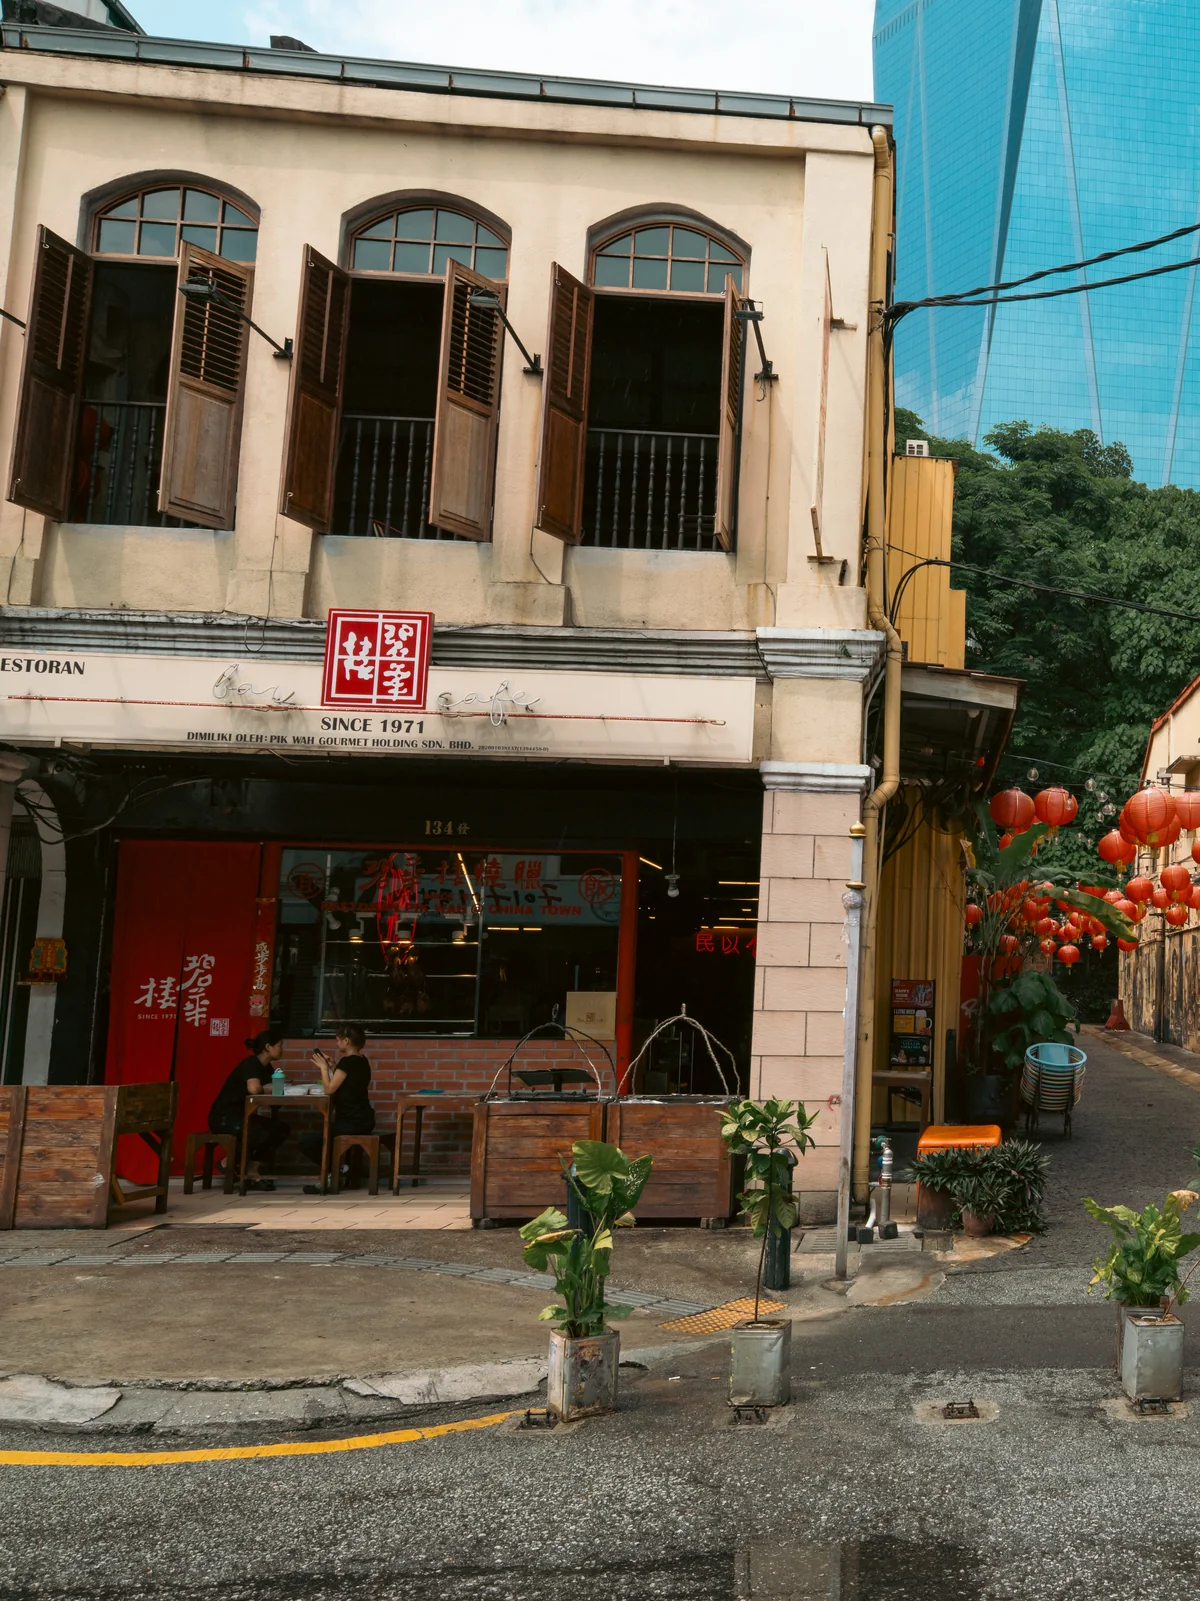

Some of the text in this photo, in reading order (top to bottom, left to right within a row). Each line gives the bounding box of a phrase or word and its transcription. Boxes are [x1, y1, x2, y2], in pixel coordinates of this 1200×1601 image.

[0, 657, 86, 676] ESTORAN
[320, 716, 425, 734] SINCE 1971
[187, 731, 232, 742] DIMILIKI
[235, 733, 268, 743] OLEH:
[269, 735, 288, 744] PIK
[292, 736, 315, 745] WAH
[318, 737, 368, 747] GOURMET
[371, 738, 418, 748] HOLDING
[421, 740, 446, 749] SDN.
[449, 741, 475, 750] BHD.
[424, 819, 455, 836] 134
[487, 904, 535, 916] CHINA
[539, 905, 582, 917] TOWN
